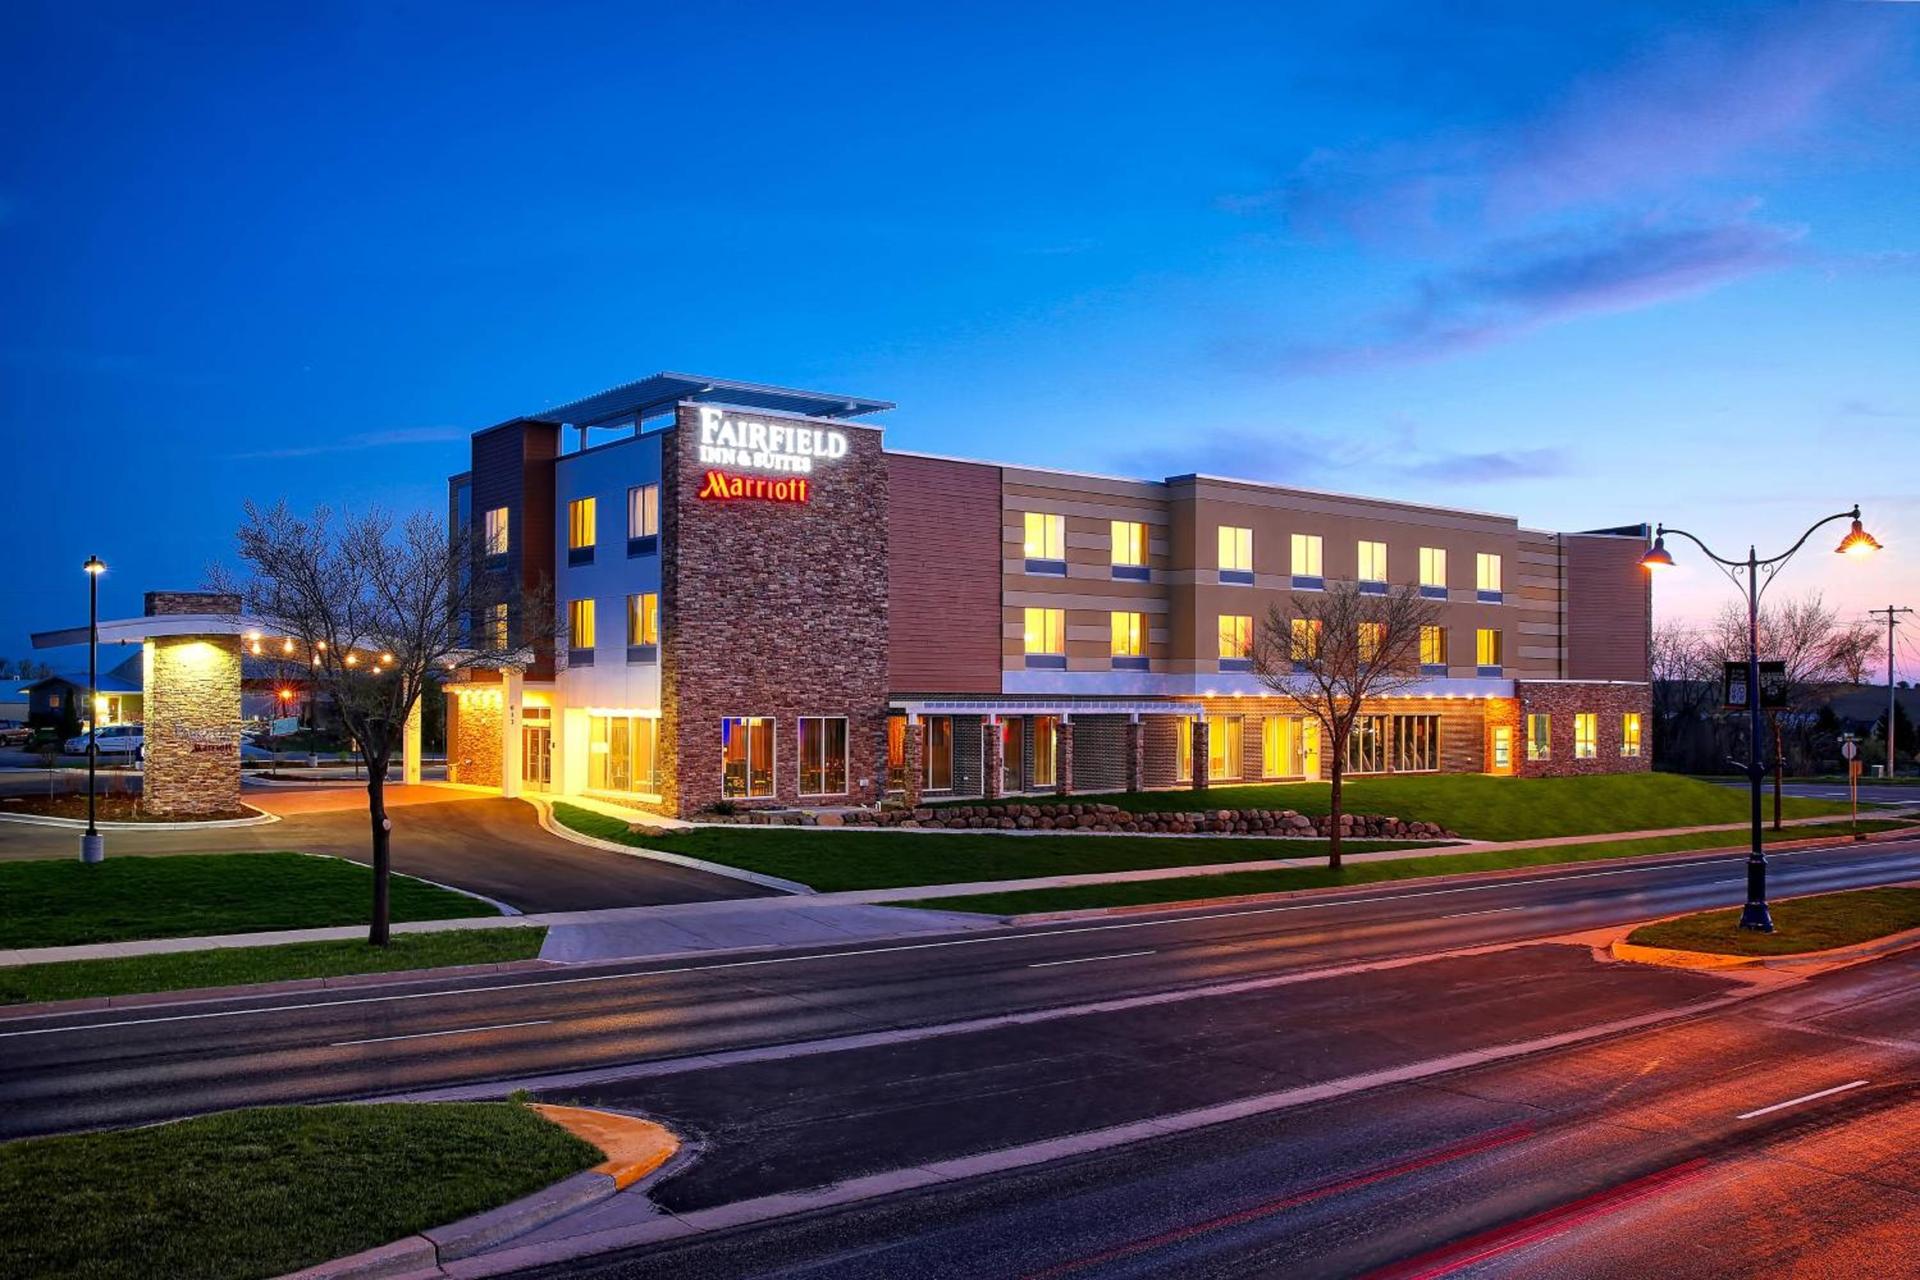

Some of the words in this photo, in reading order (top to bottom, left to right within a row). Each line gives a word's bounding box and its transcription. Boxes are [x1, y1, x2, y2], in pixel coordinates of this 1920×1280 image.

[700, 407, 848, 459] FAIRFIELD
[700, 446, 736, 465] INN
[737, 450, 751, 467] &
[753, 451, 812, 473] SUITES
[700, 470, 808, 502] Marriott
